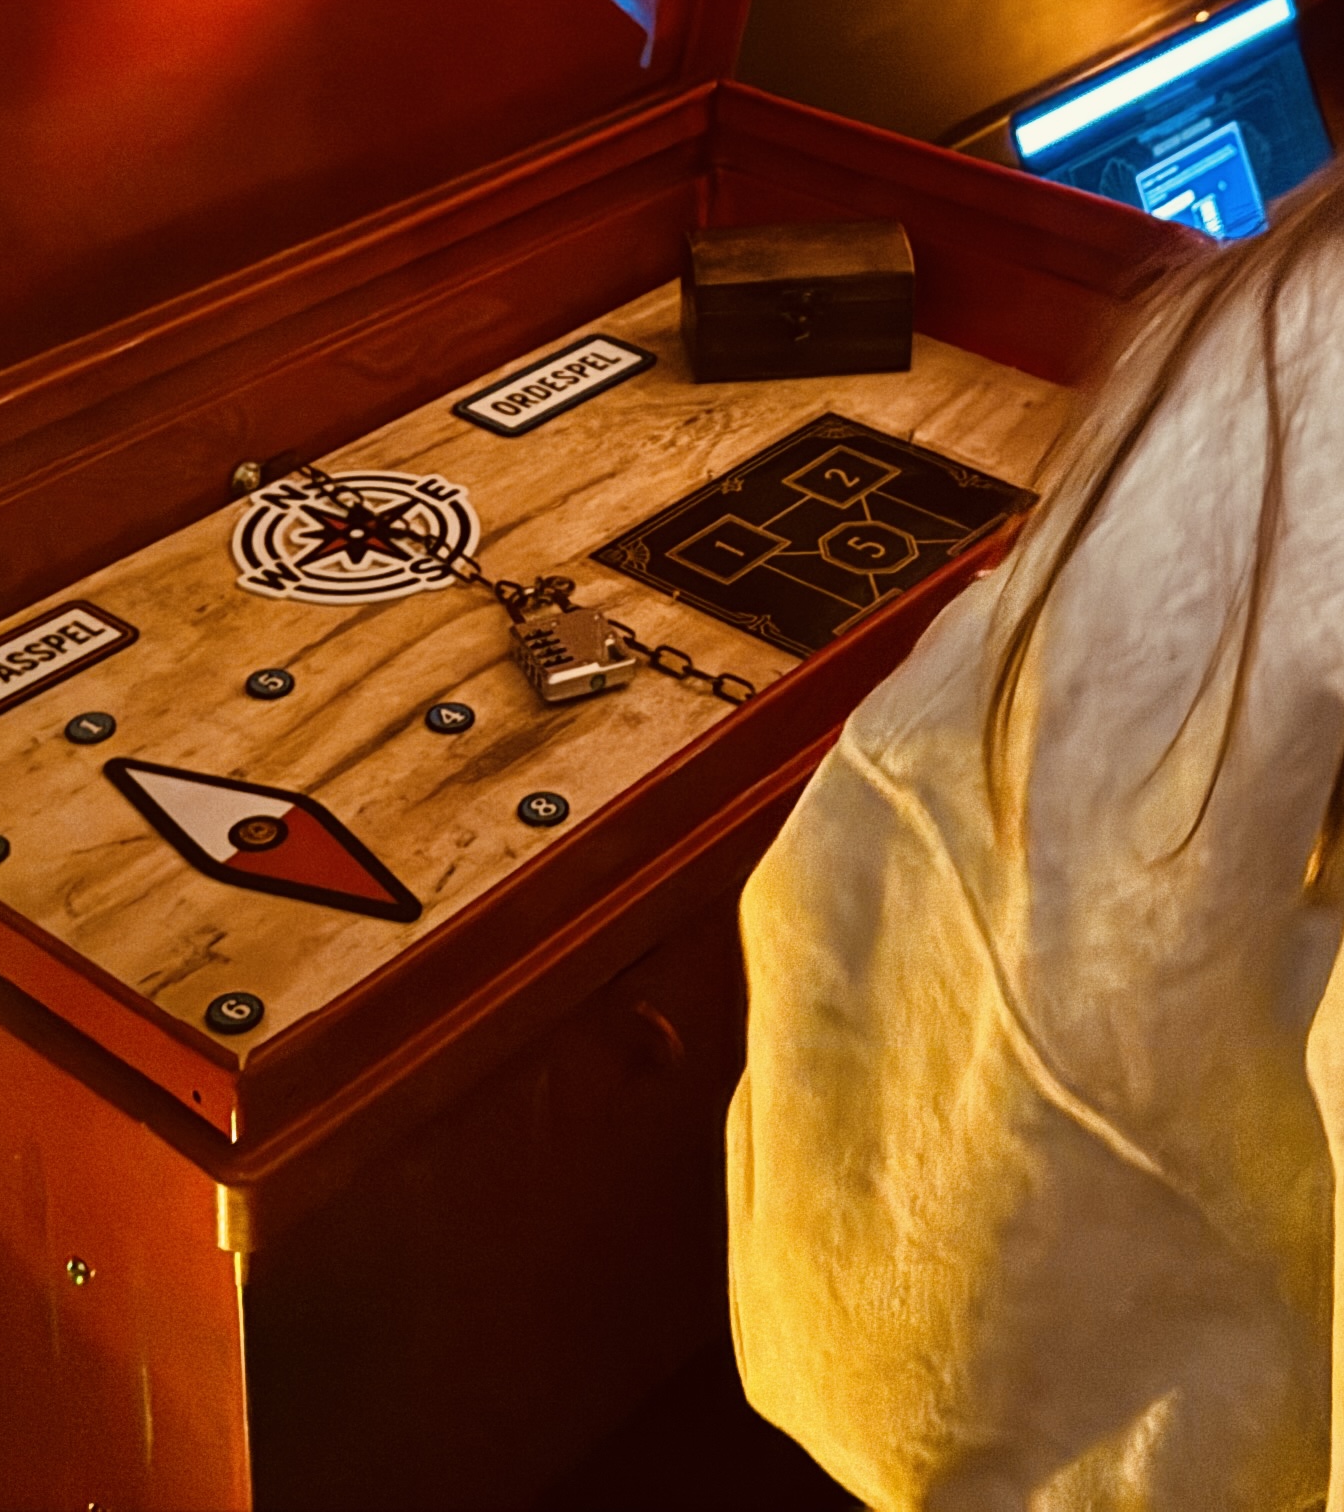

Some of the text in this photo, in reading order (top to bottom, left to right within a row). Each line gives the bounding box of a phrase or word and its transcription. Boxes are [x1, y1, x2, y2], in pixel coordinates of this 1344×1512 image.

[490, 352, 622, 416] ORDESPEL
[824, 467, 861, 489] 2
[260, 483, 310, 510] N
[416, 478, 461, 503] E
[847, 536, 886, 559] 5
[247, 561, 302, 591] W
[409, 557, 453, 583] S
[258, 674, 284, 691] 5
[440, 708, 465, 724] 4
[530, 798, 557, 816] 8
[221, 999, 251, 1019] 6
